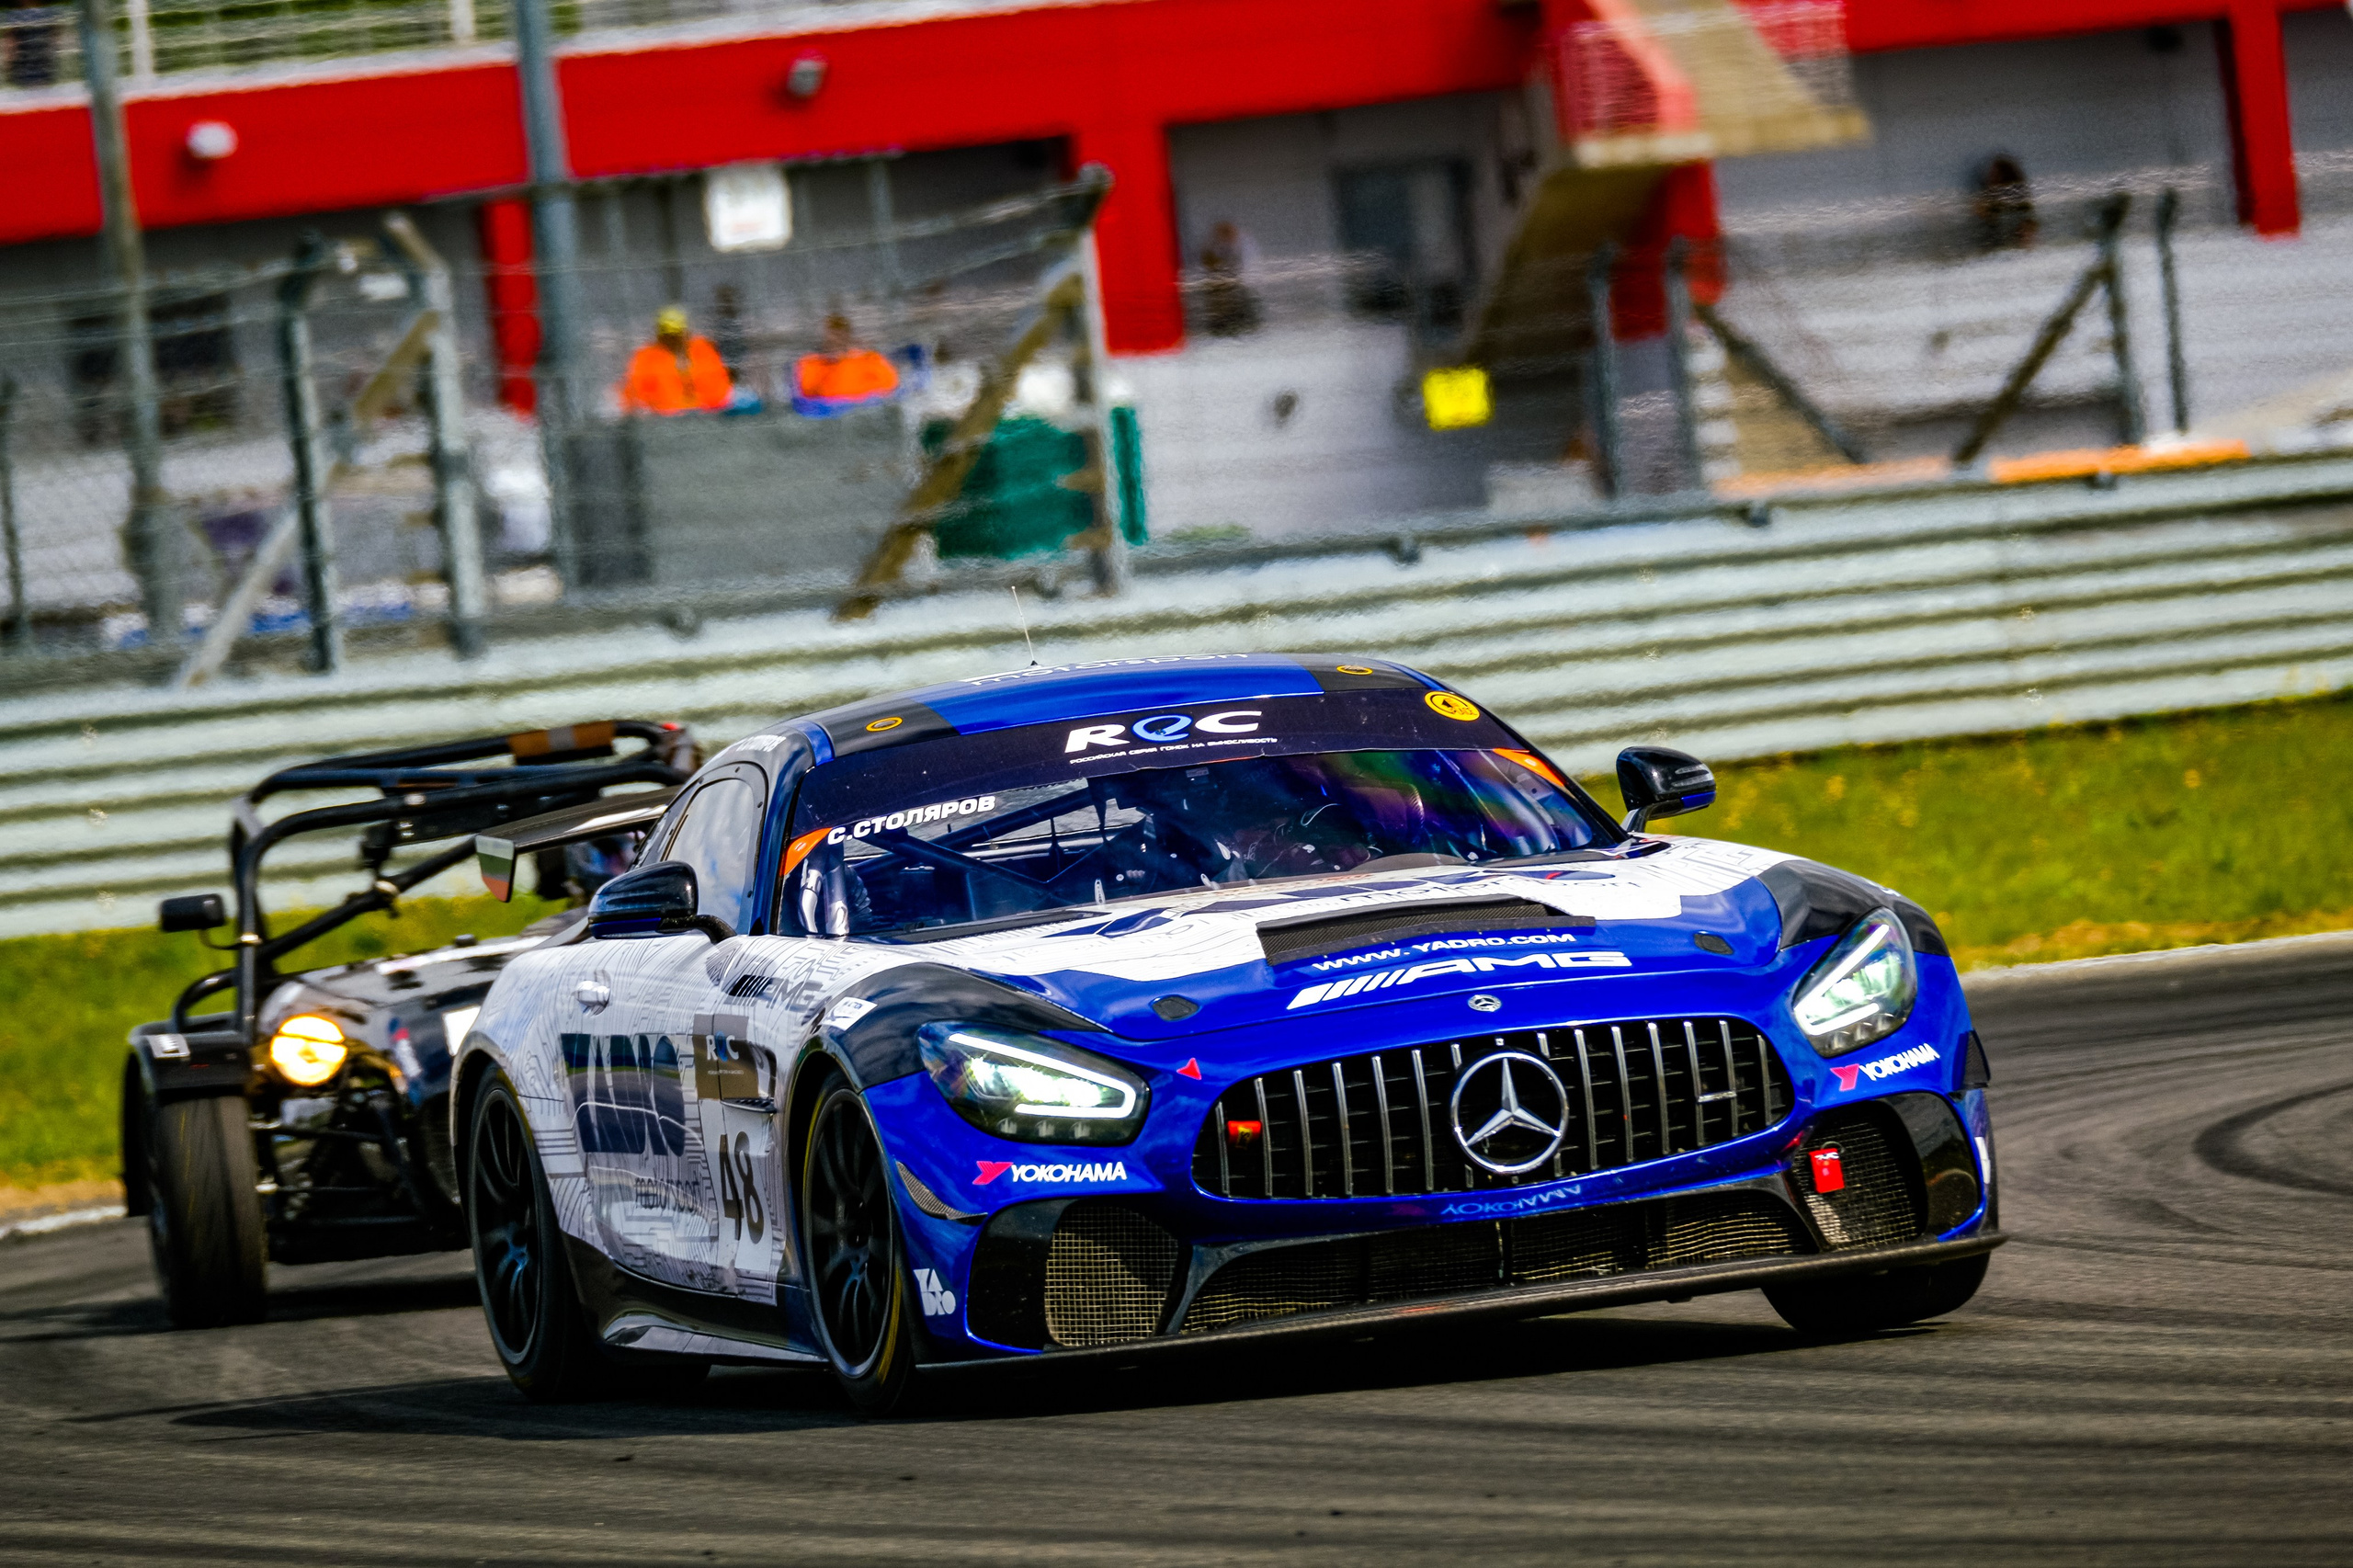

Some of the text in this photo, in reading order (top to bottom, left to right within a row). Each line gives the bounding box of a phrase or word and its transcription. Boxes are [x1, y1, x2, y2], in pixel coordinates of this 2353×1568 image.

[827, 795, 996, 845] С.СТОЛЯРОВ
[1859, 1042, 1941, 1082] YOKOHAMA
[720, 1131, 764, 1244] 48
[1011, 1161, 1128, 1183] YOKOHAMA
